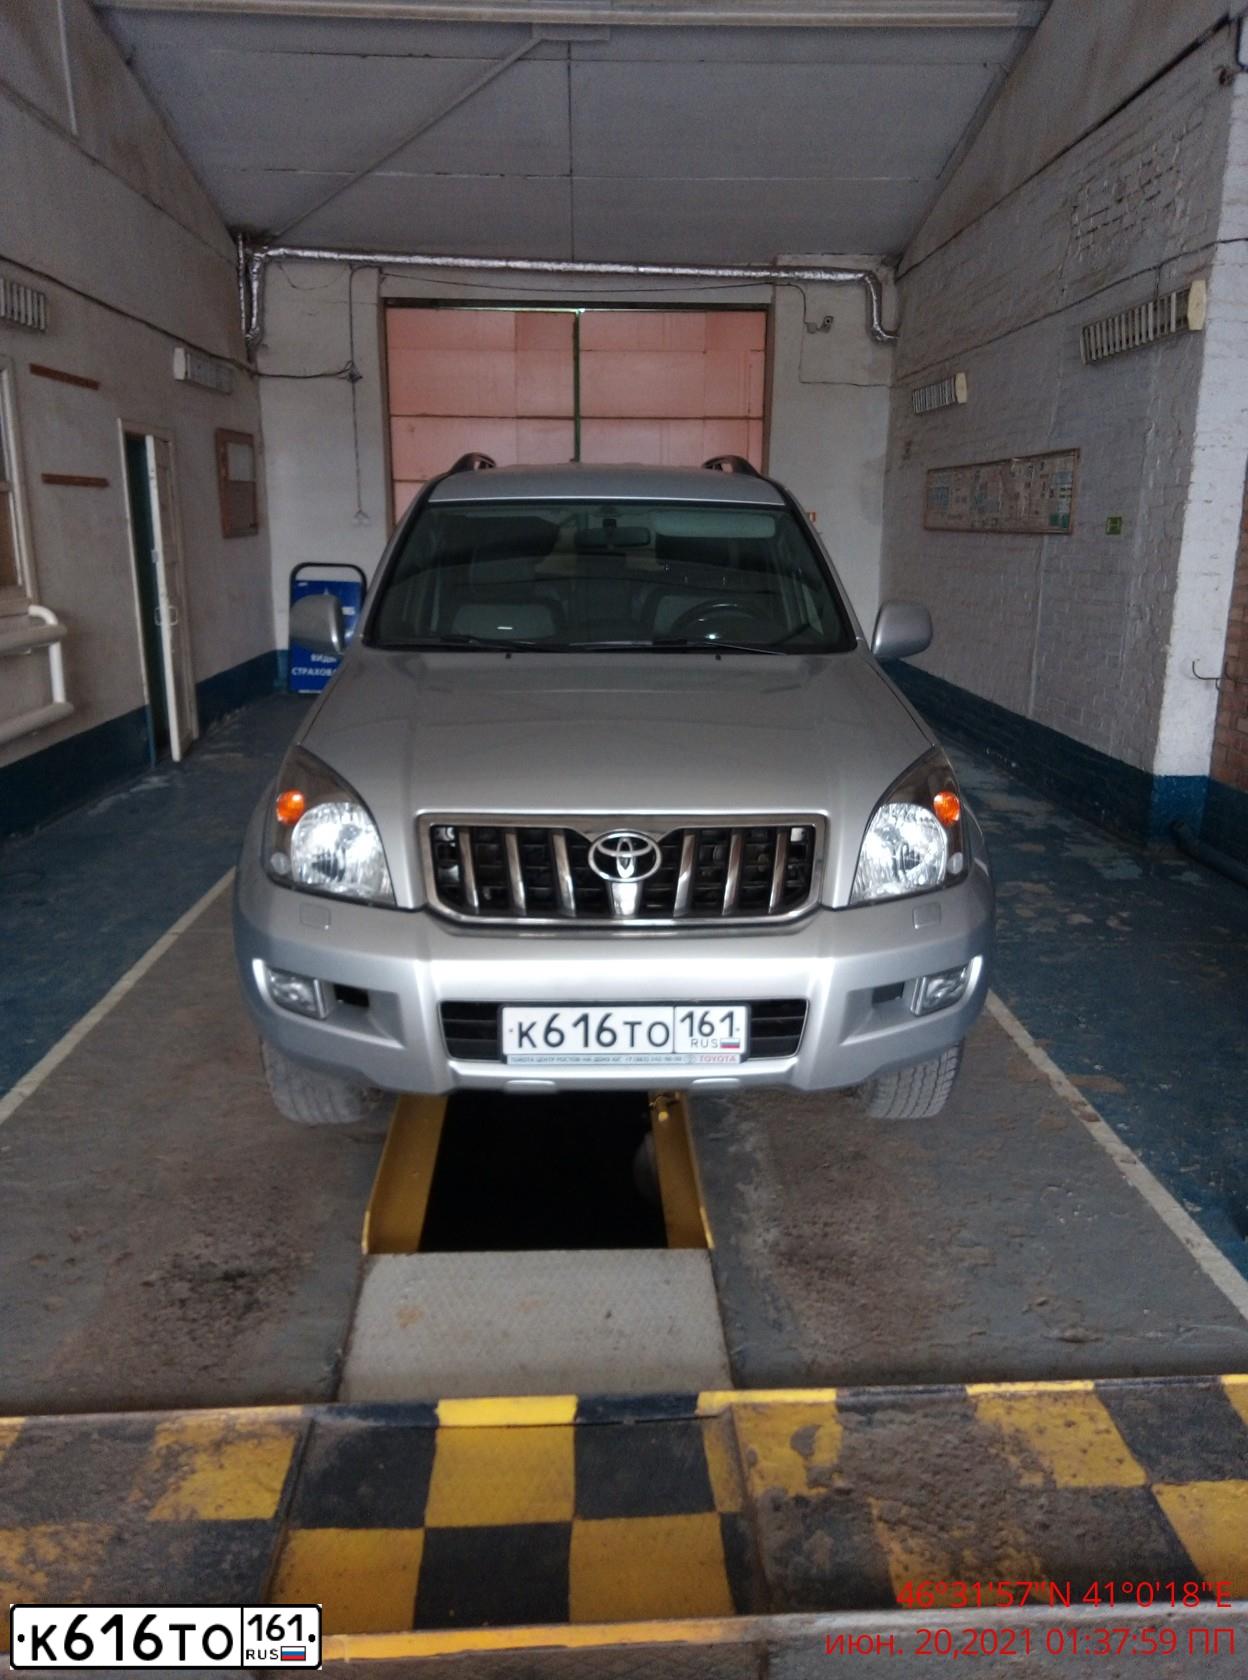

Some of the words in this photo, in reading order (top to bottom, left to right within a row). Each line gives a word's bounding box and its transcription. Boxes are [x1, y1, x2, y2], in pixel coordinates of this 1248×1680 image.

[517, 1012, 671, 1049] К616ТО
[680, 1010, 735, 1038] 161
[690, 1038, 719, 1049] RUS
[700, 1055, 737, 1063] TOYOTA
